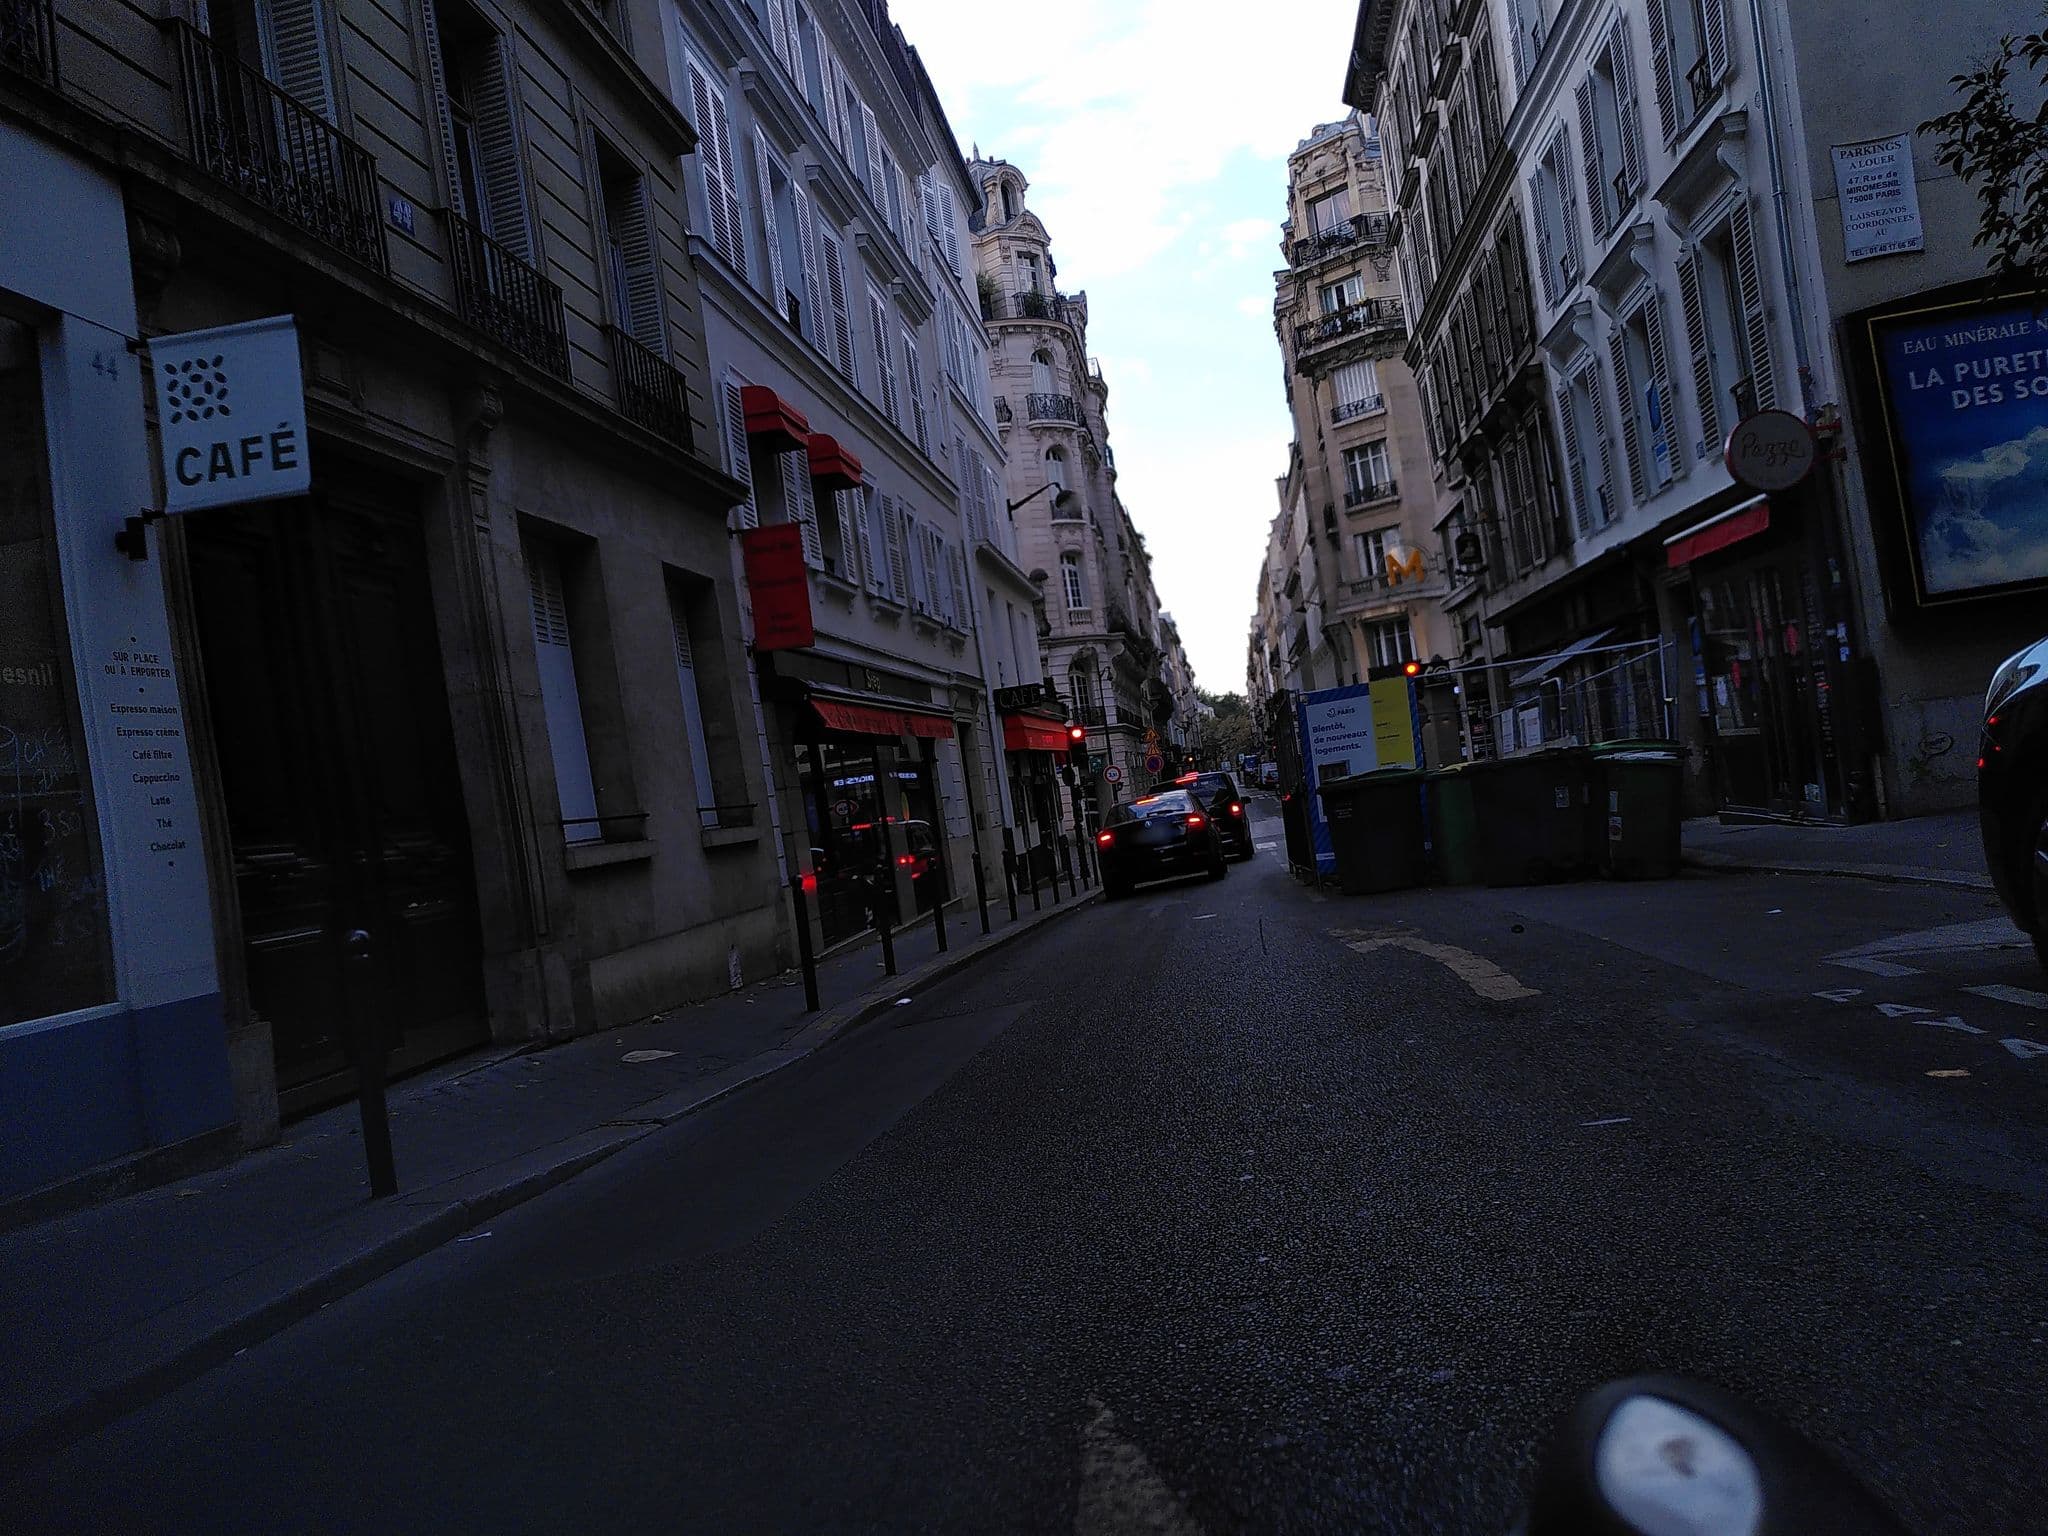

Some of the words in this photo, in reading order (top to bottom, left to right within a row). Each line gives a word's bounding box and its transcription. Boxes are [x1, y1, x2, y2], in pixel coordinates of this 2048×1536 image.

[1840, 141, 1902, 159] PARKINGS
[1849, 162, 1857, 170] A
[1859, 155, 1895, 168] LOUER
[1848, 177, 1859, 185] 47
[1863, 174, 1883, 183] Rue
[1886, 171, 1898, 179] de
[1846, 180, 1902, 195] MIROMESNIL
[1849, 193, 1874, 204] 75008
[1876, 188, 1901, 199] PARIS
[1904, 336, 1937, 354] EAU
[1944, 321, 2031, 348] MINÉRALE
[1909, 367, 1945, 390] LA
[1954, 349, 2048, 383] PURET
[1951, 384, 2004, 409] DES
[176, 421, 297, 486] CAFÉ
[112, 651, 129, 661] SUR
[133, 653, 159, 664] PLACE
[104, 664, 116, 675] OU
[130, 666, 171, 678] EMPORTER
[110, 703, 148, 715] Expresso
[149, 705, 178, 714] maison
[116, 726, 154, 738] Expresso
[1312, 722, 1346, 734] Bientôt,
[1314, 736, 1325, 744] de
[1327, 730, 1368, 741] nouveaux
[132, 750, 152, 760] Café
[153, 750, 173, 760] filtre
[1315, 742, 1362, 755] logements.
[132, 772, 180, 784] Cappuccino
[150, 796, 171, 806] Latte
[156, 816, 172, 828] Thé
[150, 840, 186, 852] Chocolat
